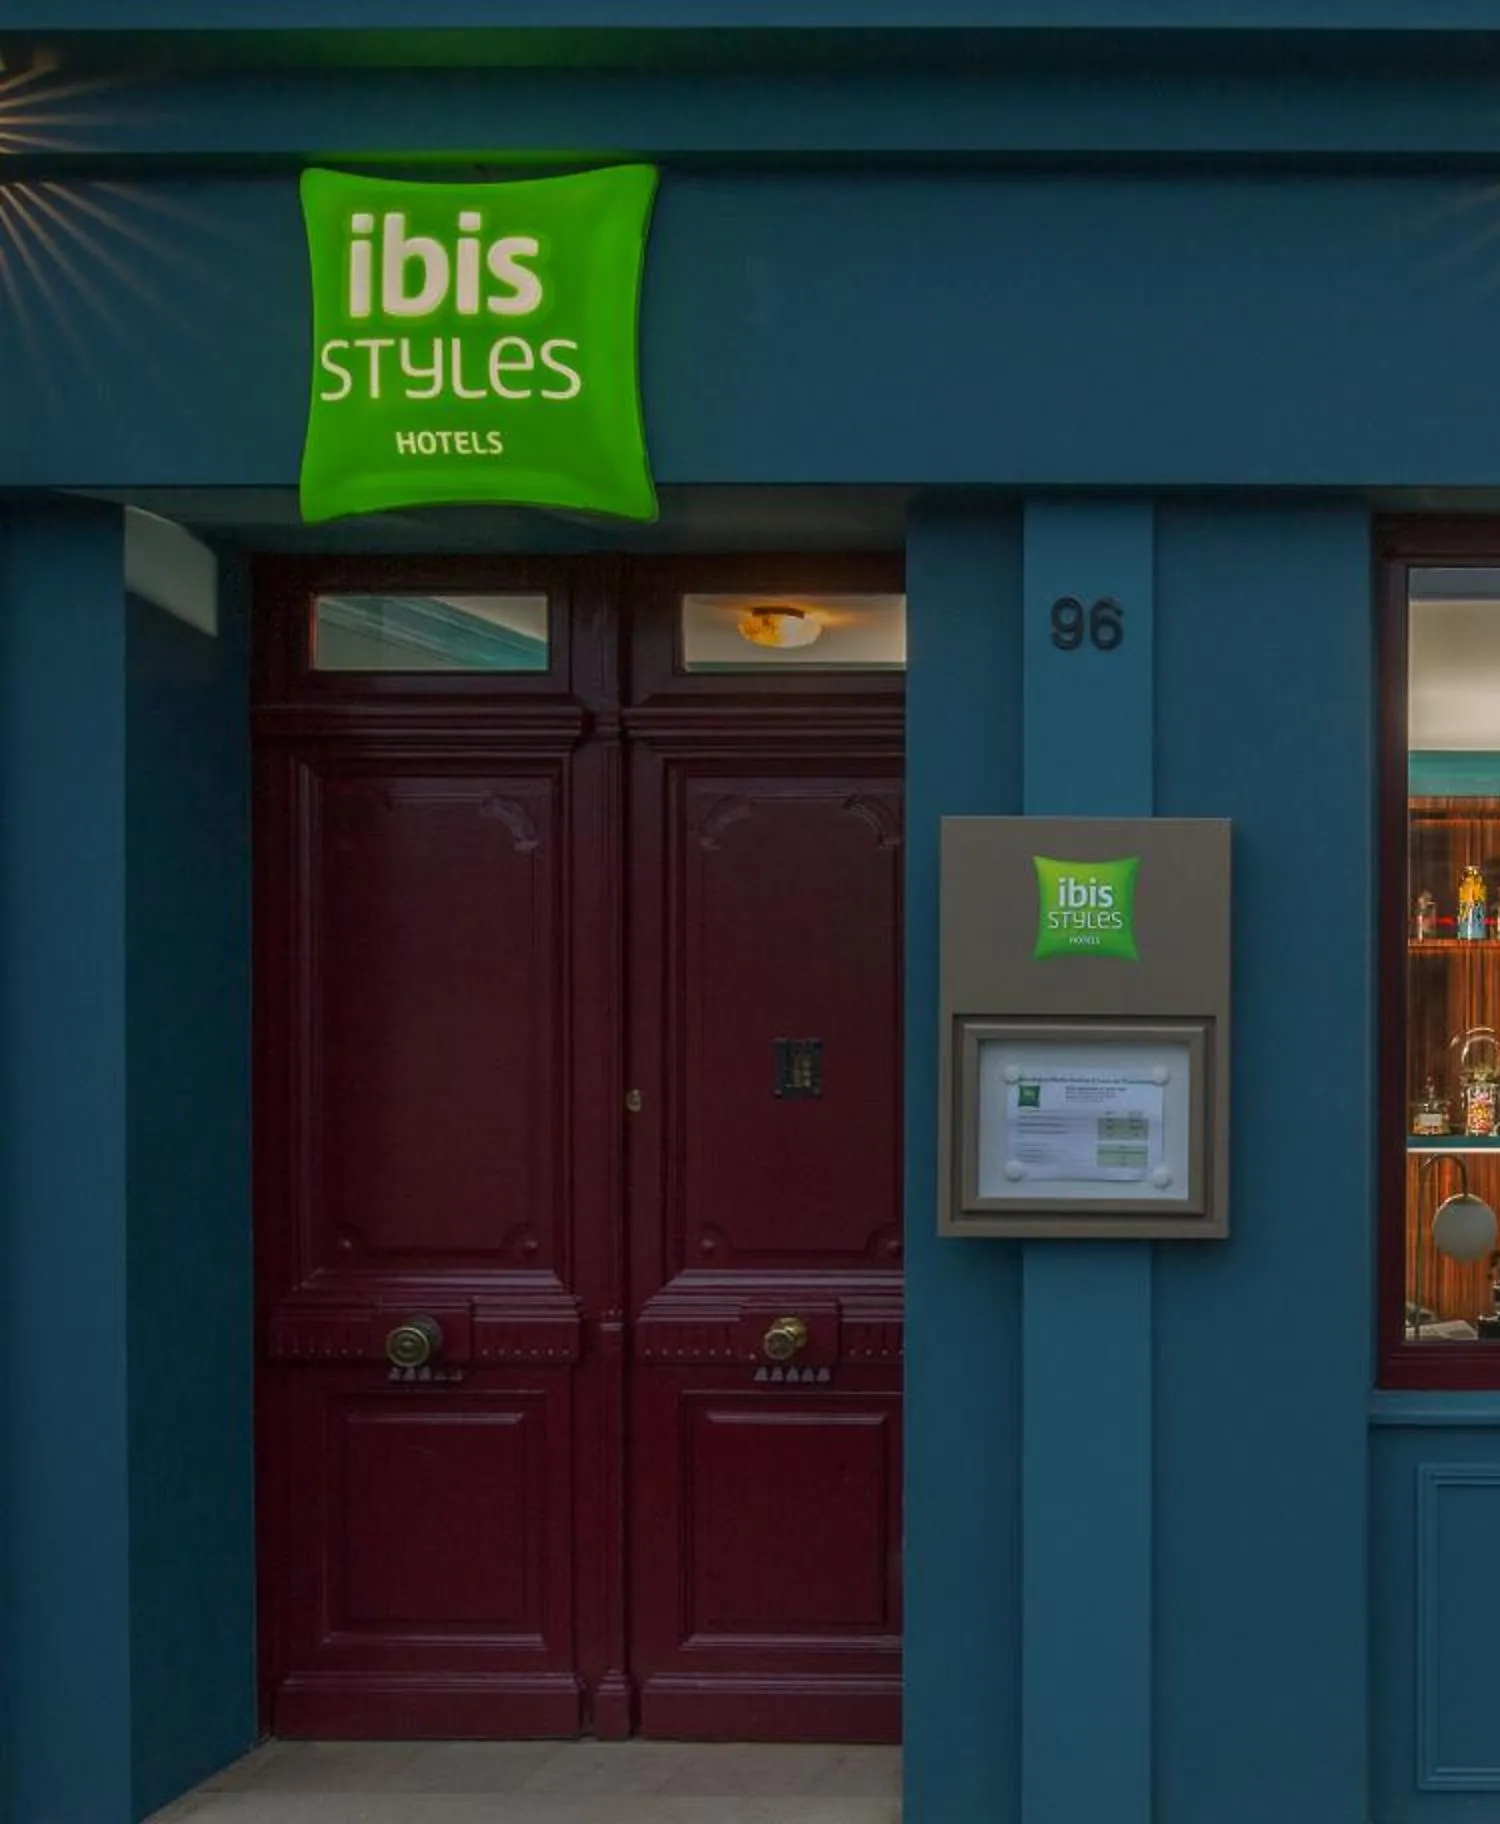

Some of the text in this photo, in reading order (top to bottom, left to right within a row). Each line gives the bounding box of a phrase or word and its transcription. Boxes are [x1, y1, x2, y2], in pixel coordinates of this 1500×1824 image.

[348, 211, 544, 318] ibis
[395, 430, 504, 455] HOTELS
[1051, 596, 1124, 651] 96
[1058, 877, 1114, 908] ibis
